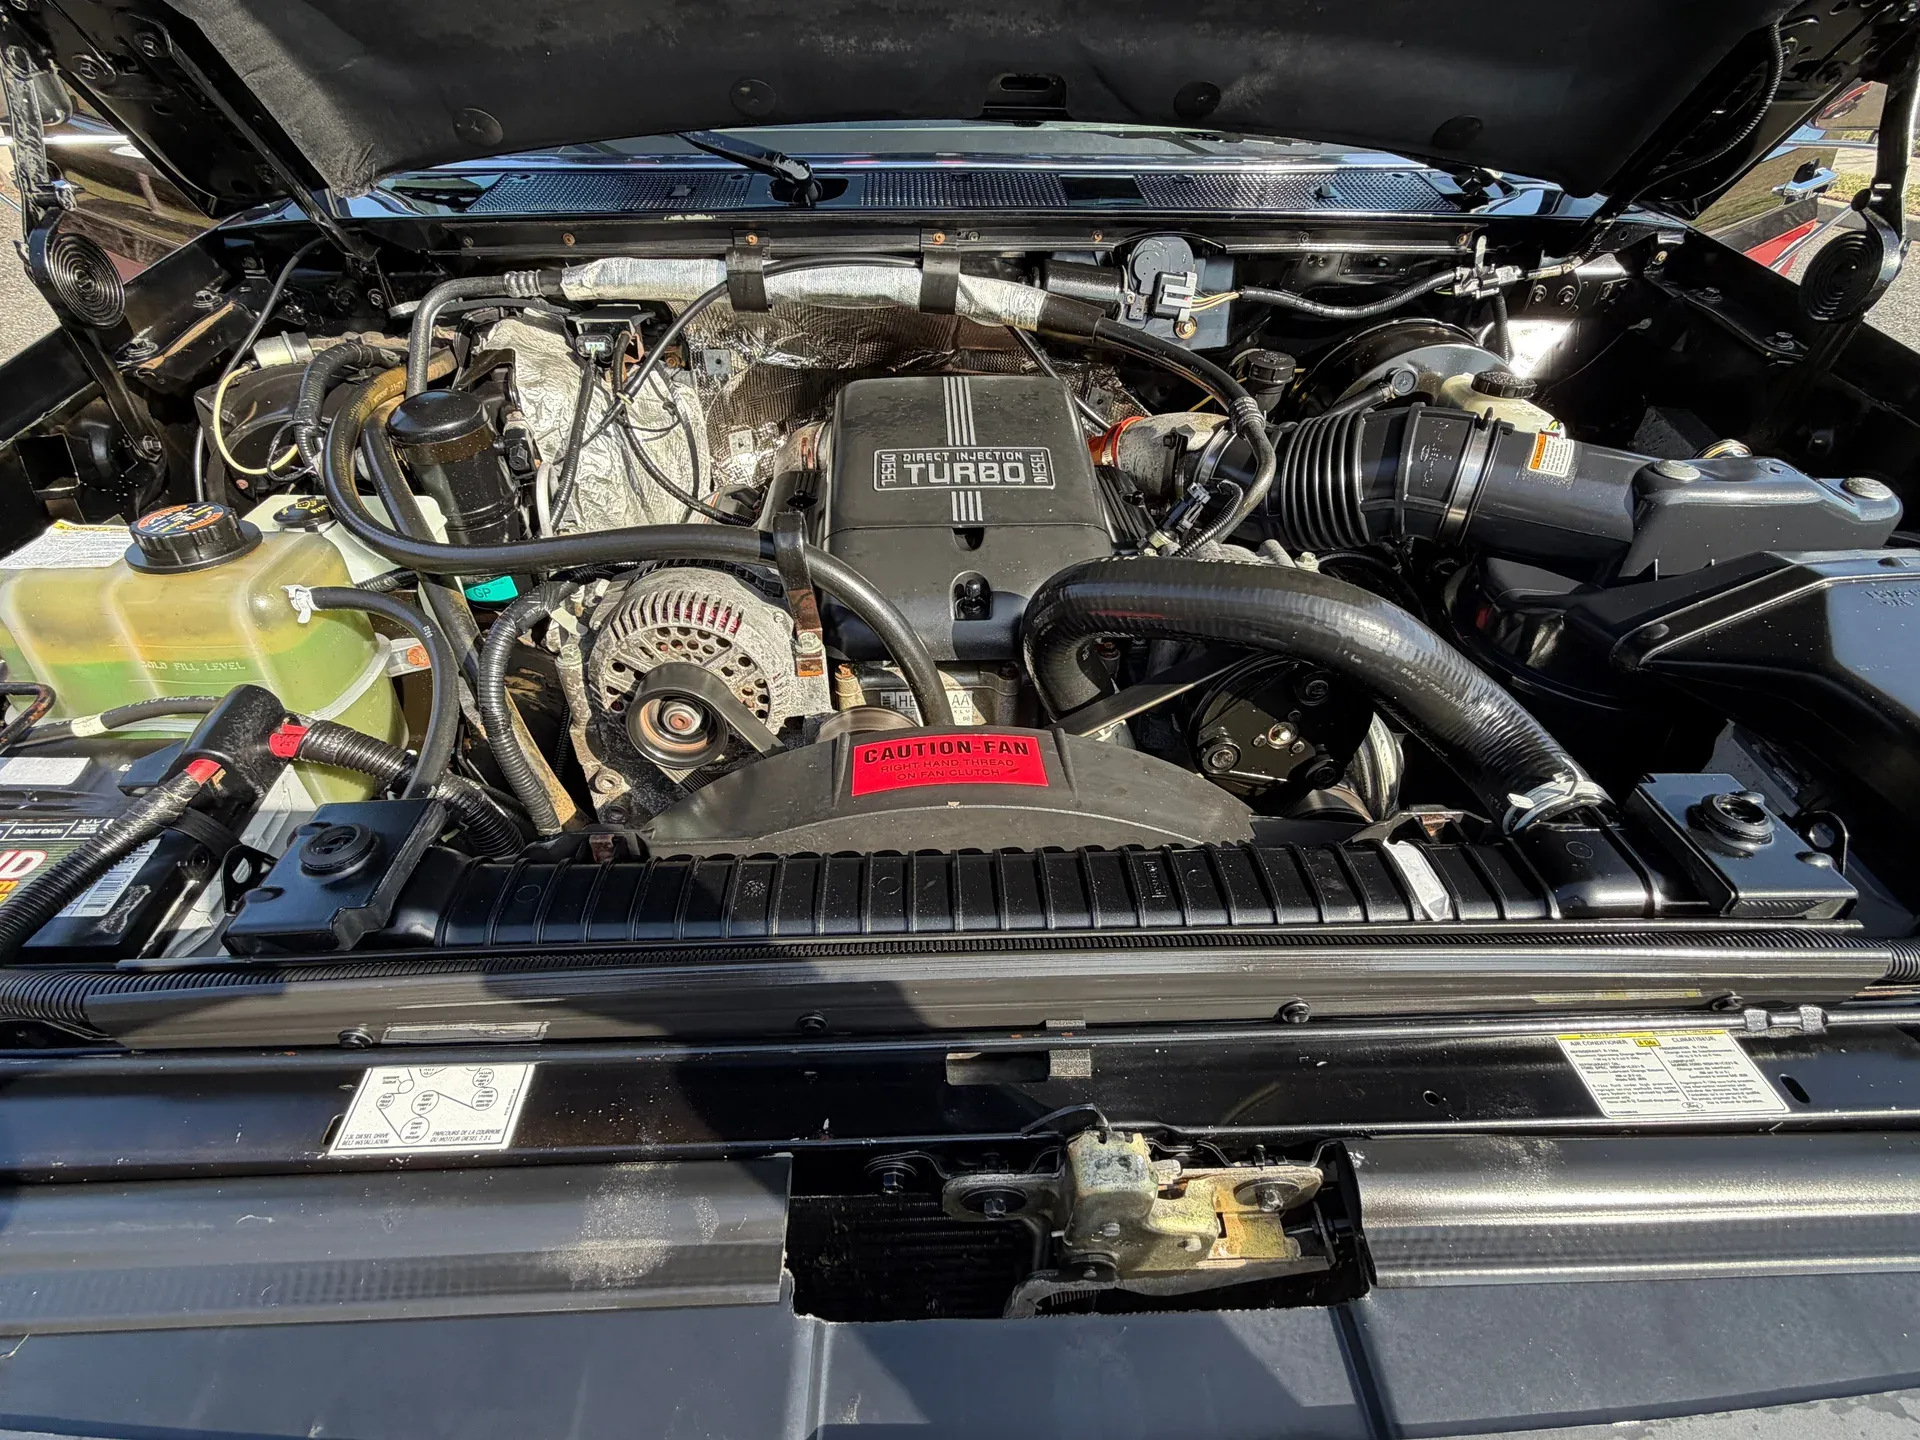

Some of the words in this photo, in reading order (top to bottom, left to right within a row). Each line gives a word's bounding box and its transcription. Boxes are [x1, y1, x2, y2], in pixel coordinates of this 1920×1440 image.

[902, 452, 950, 462] DIRECT
[956, 451, 1023, 461] INJECTION
[881, 454, 896, 486] DIESEL
[903, 462, 1026, 485] TURBO
[1029, 452, 1048, 483] DIESEL
[473, 587, 491, 598] GP
[173, 662, 199, 671] FILL
[204, 661, 246, 671] LEVEL
[951, 694, 970, 706] AA
[864, 740, 1029, 764] CAUTION-FAN
[880, 762, 919, 773] RIGHT
[923, 759, 960, 768] HAND
[962, 758, 1014, 767] THREAD
[897, 772, 916, 781] ON
[920, 769, 945, 778] FAN
[949, 768, 1000, 777] CLUTCH
